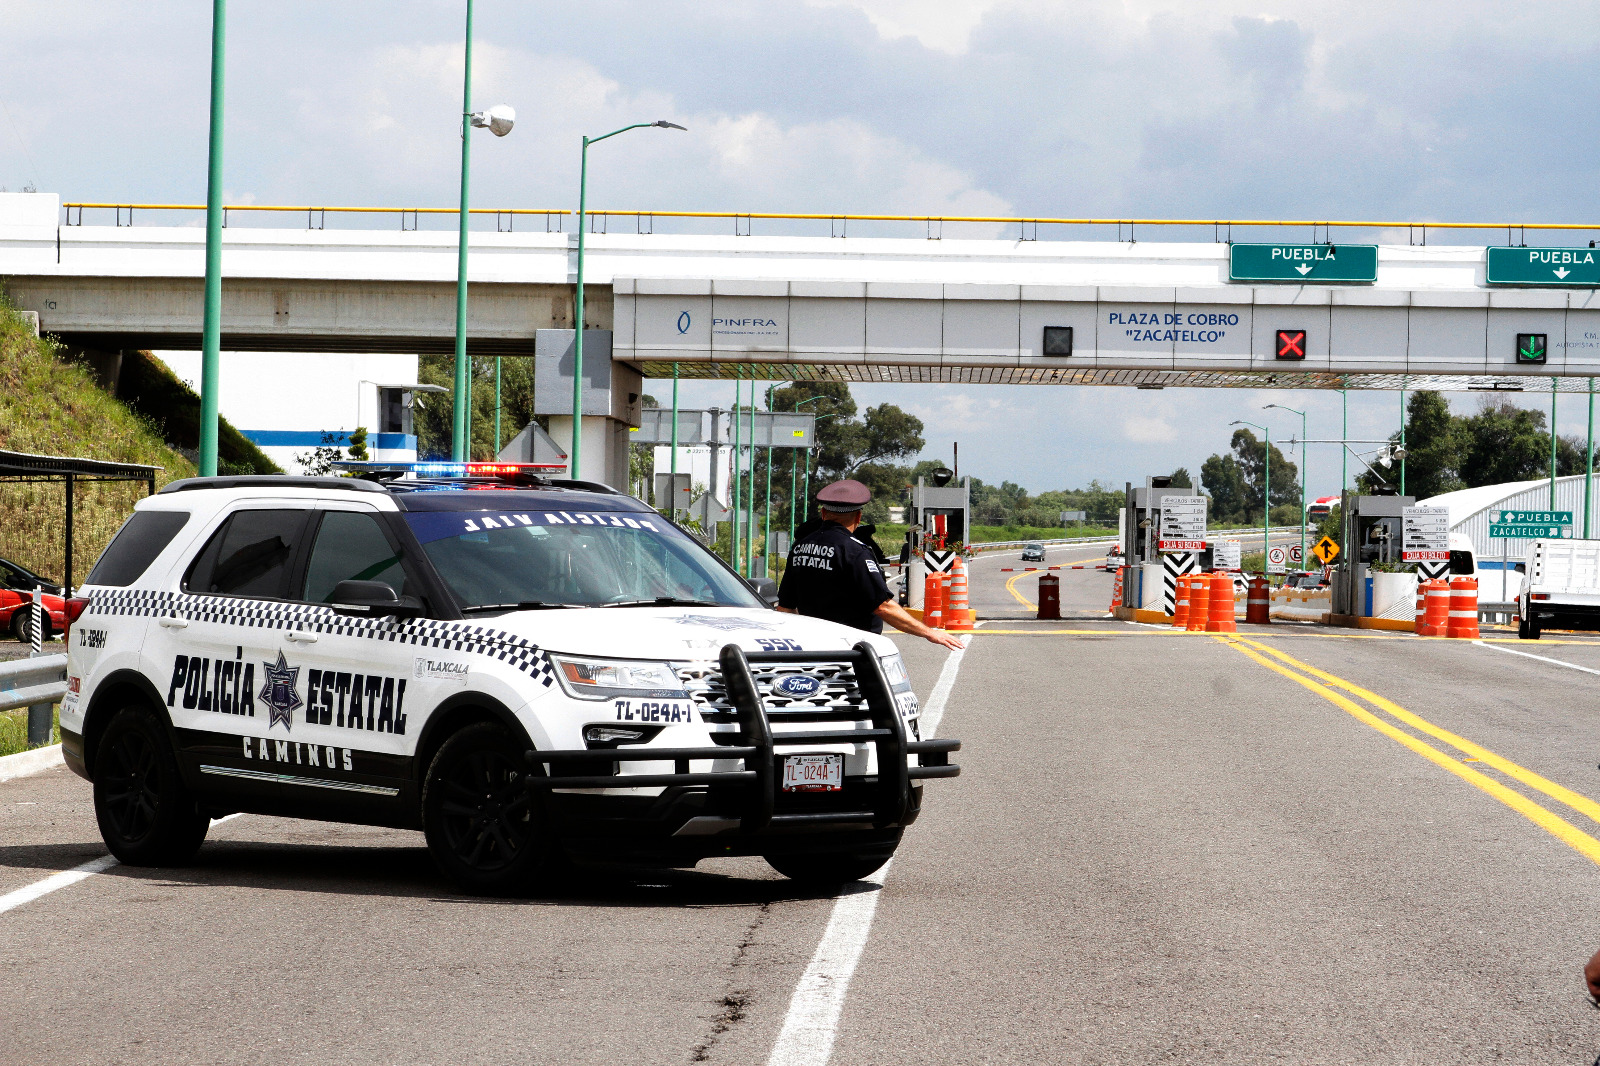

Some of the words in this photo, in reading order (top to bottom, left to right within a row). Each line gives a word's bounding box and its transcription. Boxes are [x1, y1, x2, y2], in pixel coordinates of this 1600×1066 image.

[1272, 248, 1336, 261] PUEBLA
[1529, 251, 1595, 264] PUEBLA
[713, 318, 777, 327] PINFRA
[1109, 313, 1159, 325] PLAZA
[1164, 313, 1183, 325] DE
[1188, 313, 1239, 326] COBRO
[1126, 330, 1225, 342] "ZACATELCO"
[1517, 513, 1569, 522] PUEBLA
[1492, 527, 1545, 536] ZACATELCO
[793, 543, 835, 557] CAMINOS
[792, 555, 833, 570] ESTATAL
[754, 638, 803, 651] SSC
[427, 660, 469, 674] TLAXCALA
[167, 646, 255, 717] POLICÍA
[306, 668, 407, 735] ESTATAL
[788, 678, 813, 691] Ford
[615, 701, 691, 723] TL-024A-1
[242, 737, 353, 770] CAMINOS
[786, 764, 840, 781] TL-024A-1
